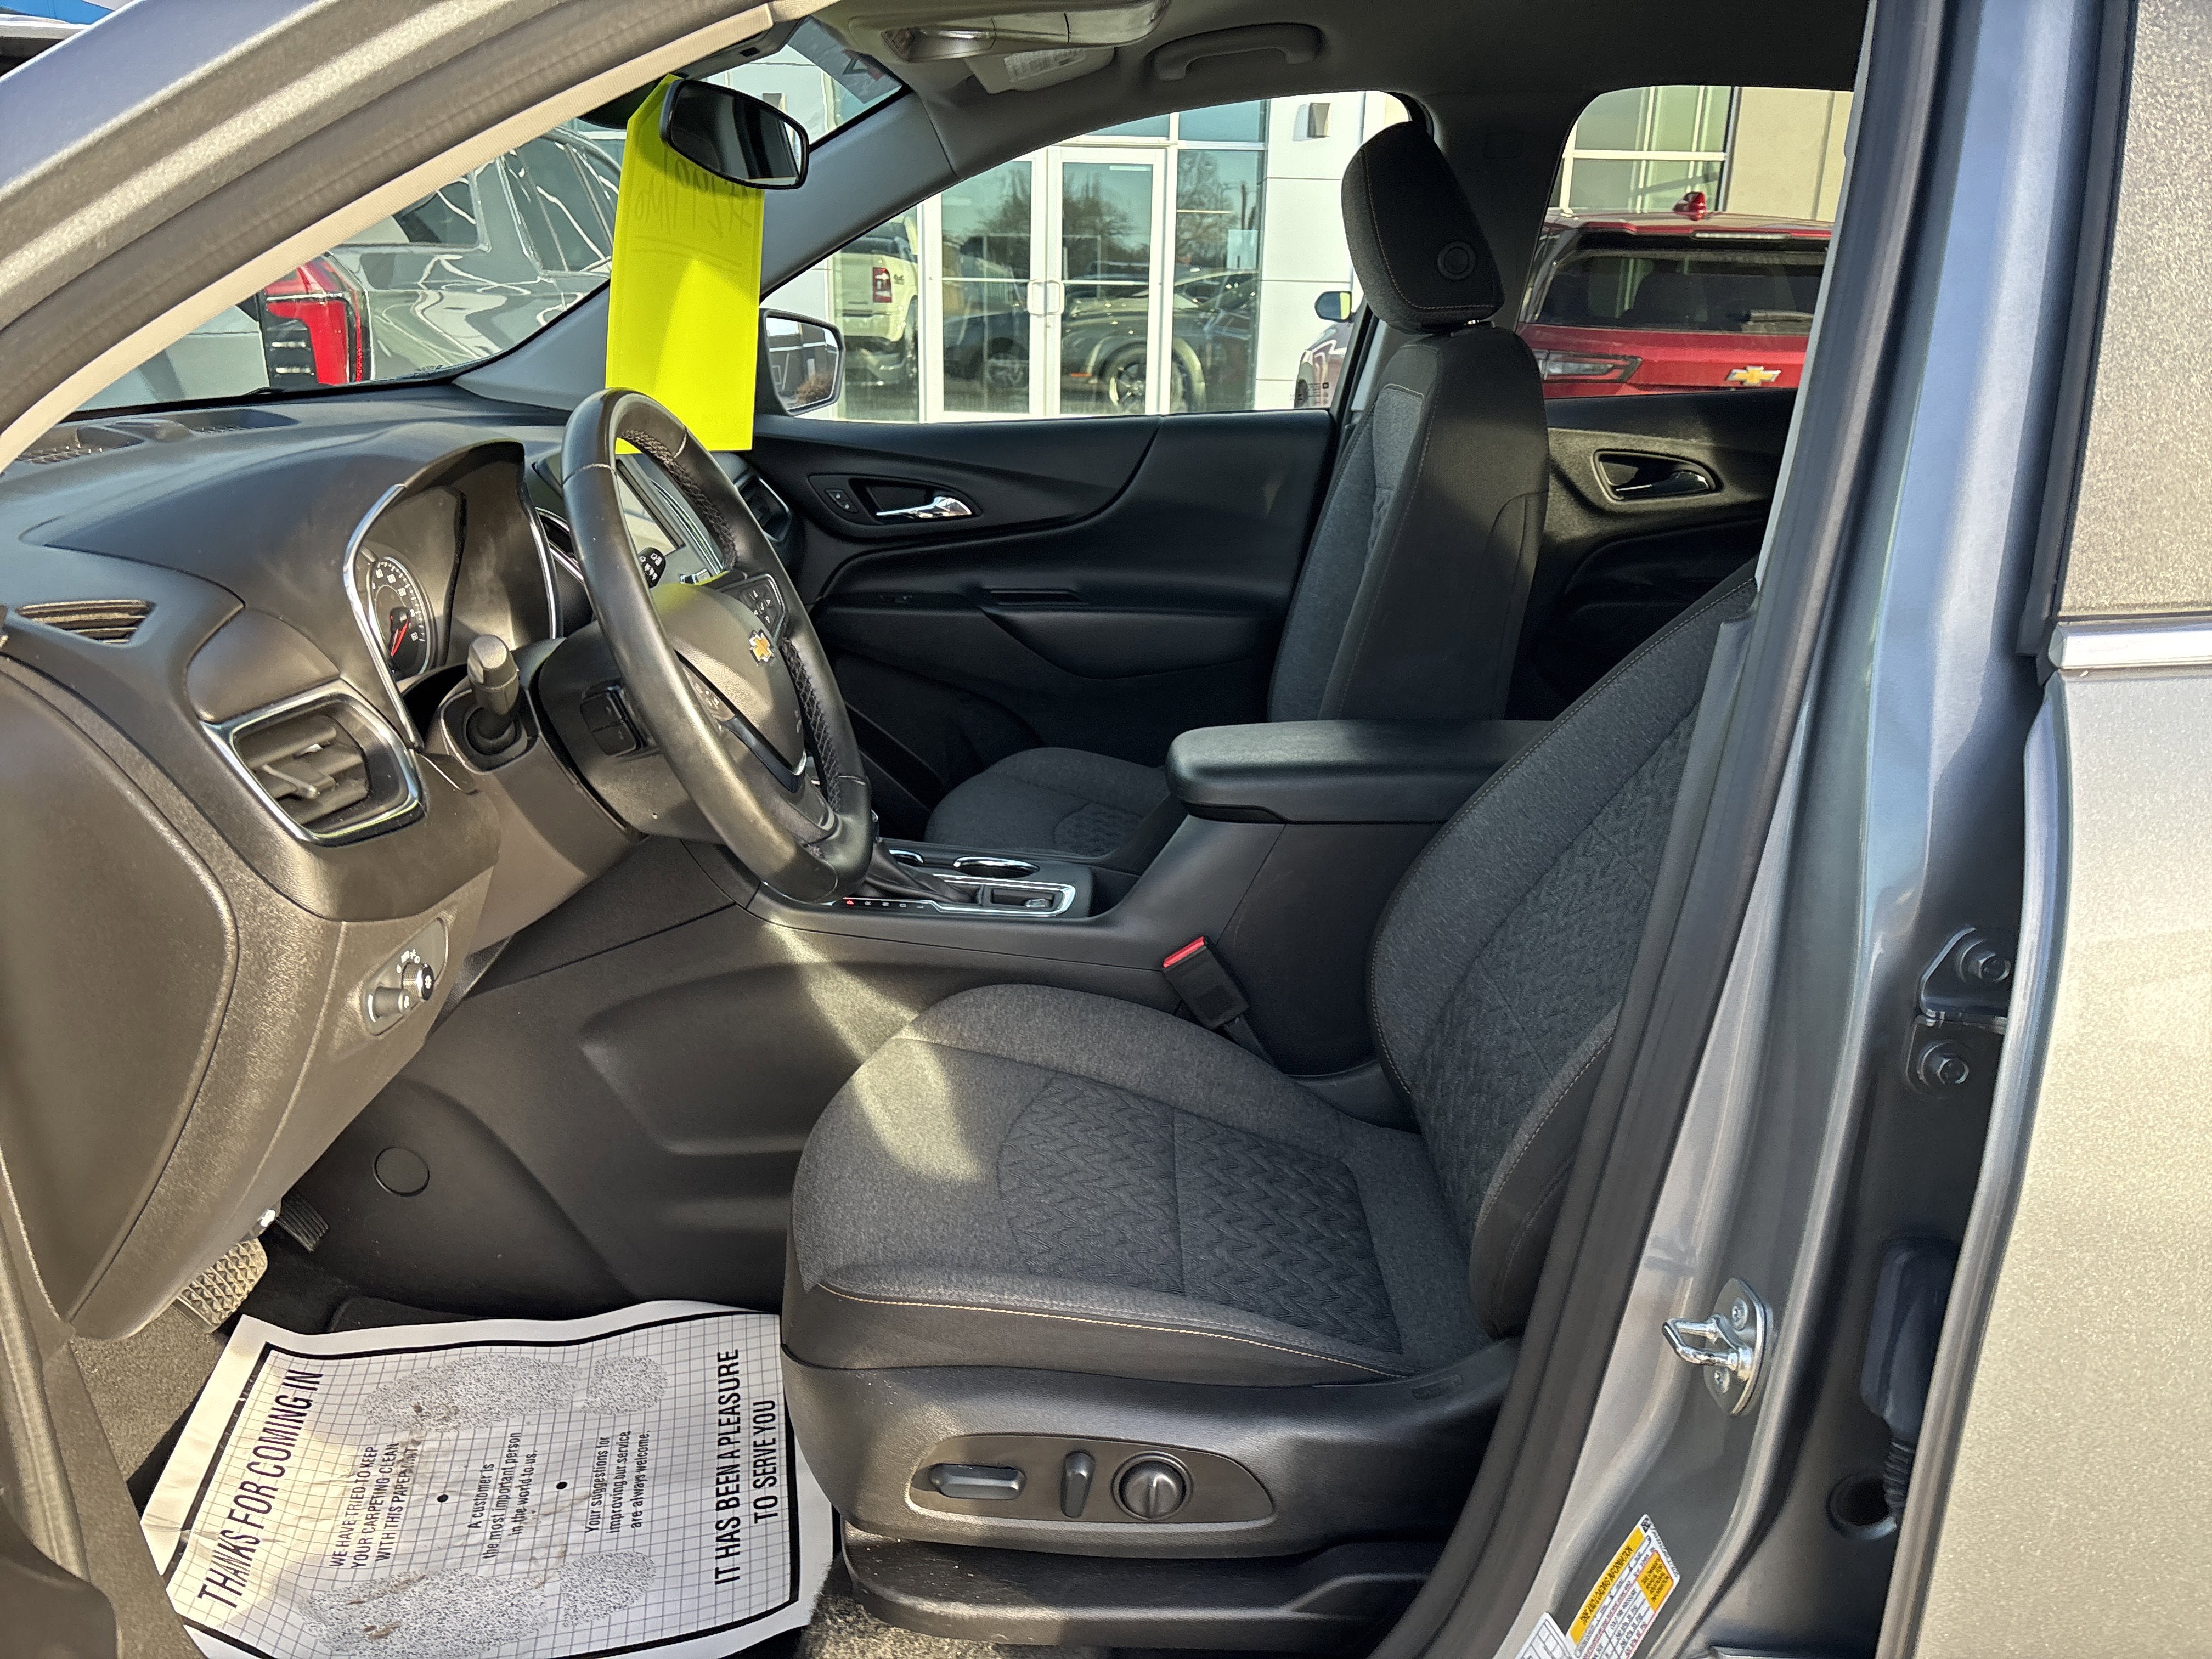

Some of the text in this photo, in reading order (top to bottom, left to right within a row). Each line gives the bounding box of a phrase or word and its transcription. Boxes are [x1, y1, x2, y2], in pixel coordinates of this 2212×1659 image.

[198, 1369, 324, 1609] THANKS FOR COMING IN
[482, 1432, 521, 1559] the most important person
[514, 1477, 533, 1506] world
[521, 1466, 535, 1477] to
[585, 1437, 610, 1534] Your suggestions for
[606, 1430, 631, 1534] improving our service
[630, 1474, 648, 1508] always
[714, 1349, 741, 1585] IT HAS BEEN A PLEASURE
[753, 1400, 778, 1525] TO SERVE YOU
[329, 1447, 379, 1567] WE HAVE TRIED TO KEEP
[351, 1442, 399, 1569] YOUR CARPETING CLEAN
[384, 1506, 404, 1530] THIS
[467, 1463, 494, 1529] A customer is
[511, 1508, 527, 1523] the
[631, 1510, 643, 1529] are
[375, 1532, 397, 1562] WITH
[508, 1525, 524, 1537] in
